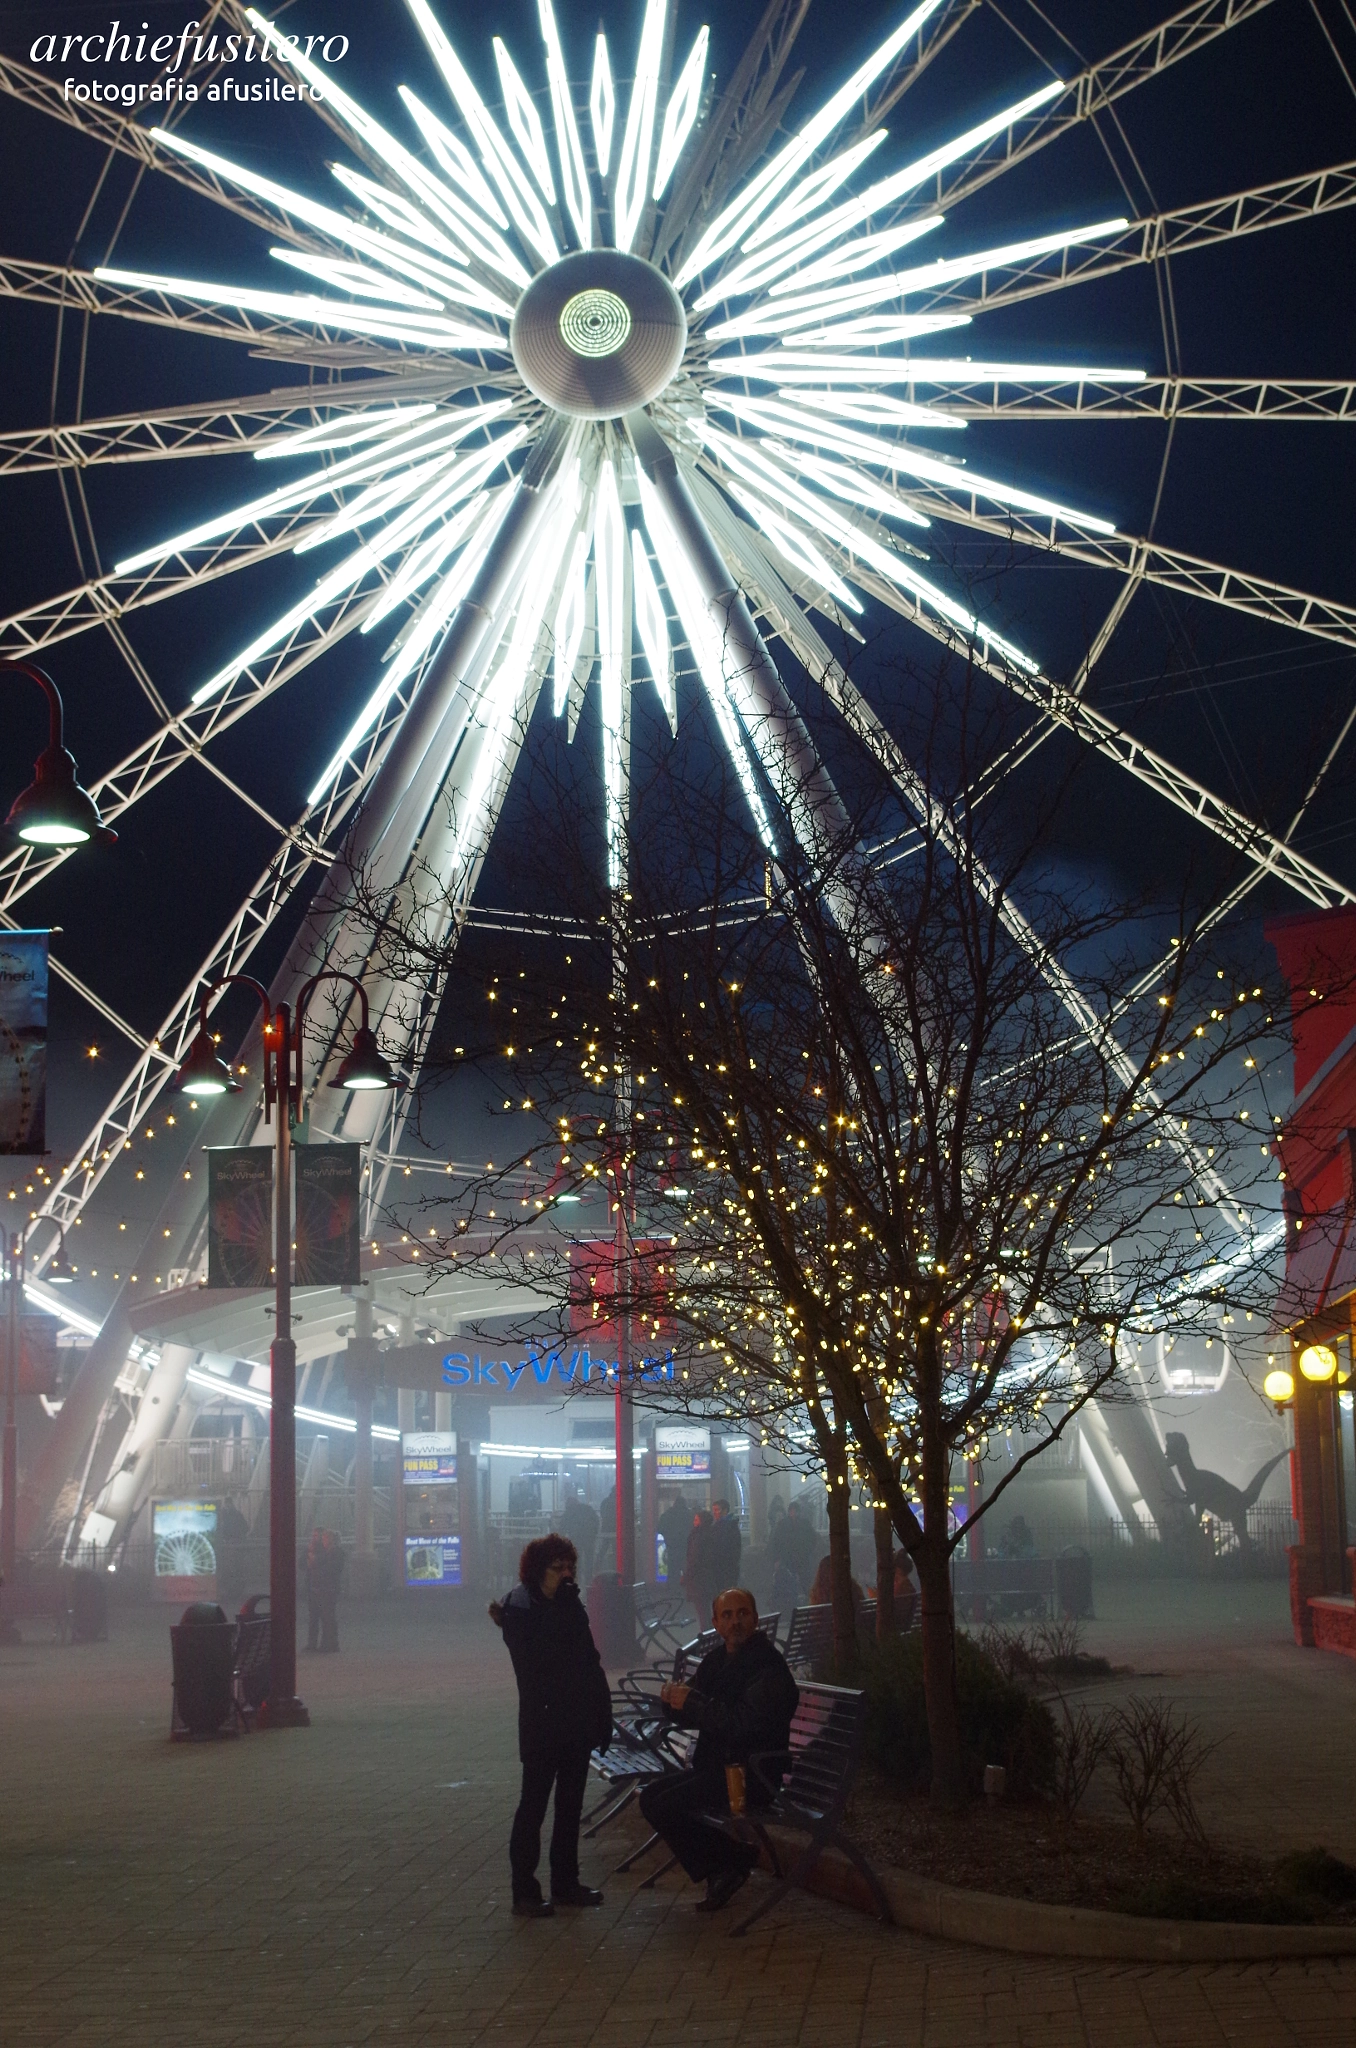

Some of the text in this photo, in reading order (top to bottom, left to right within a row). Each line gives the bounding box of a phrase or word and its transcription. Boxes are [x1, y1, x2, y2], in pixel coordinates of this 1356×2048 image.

[0, 970, 35, 982] heel
[217, 1170, 265, 1181] SkyWheel
[303, 1167, 352, 1179] SkyWheel
[405, 1445, 452, 1455] SkyWheel
[659, 1440, 705, 1449] SkyWheel
[403, 1460, 418, 1471] FUN
[419, 1459, 439, 1471] PASS
[656, 1455, 693, 1466] FUN PASS
